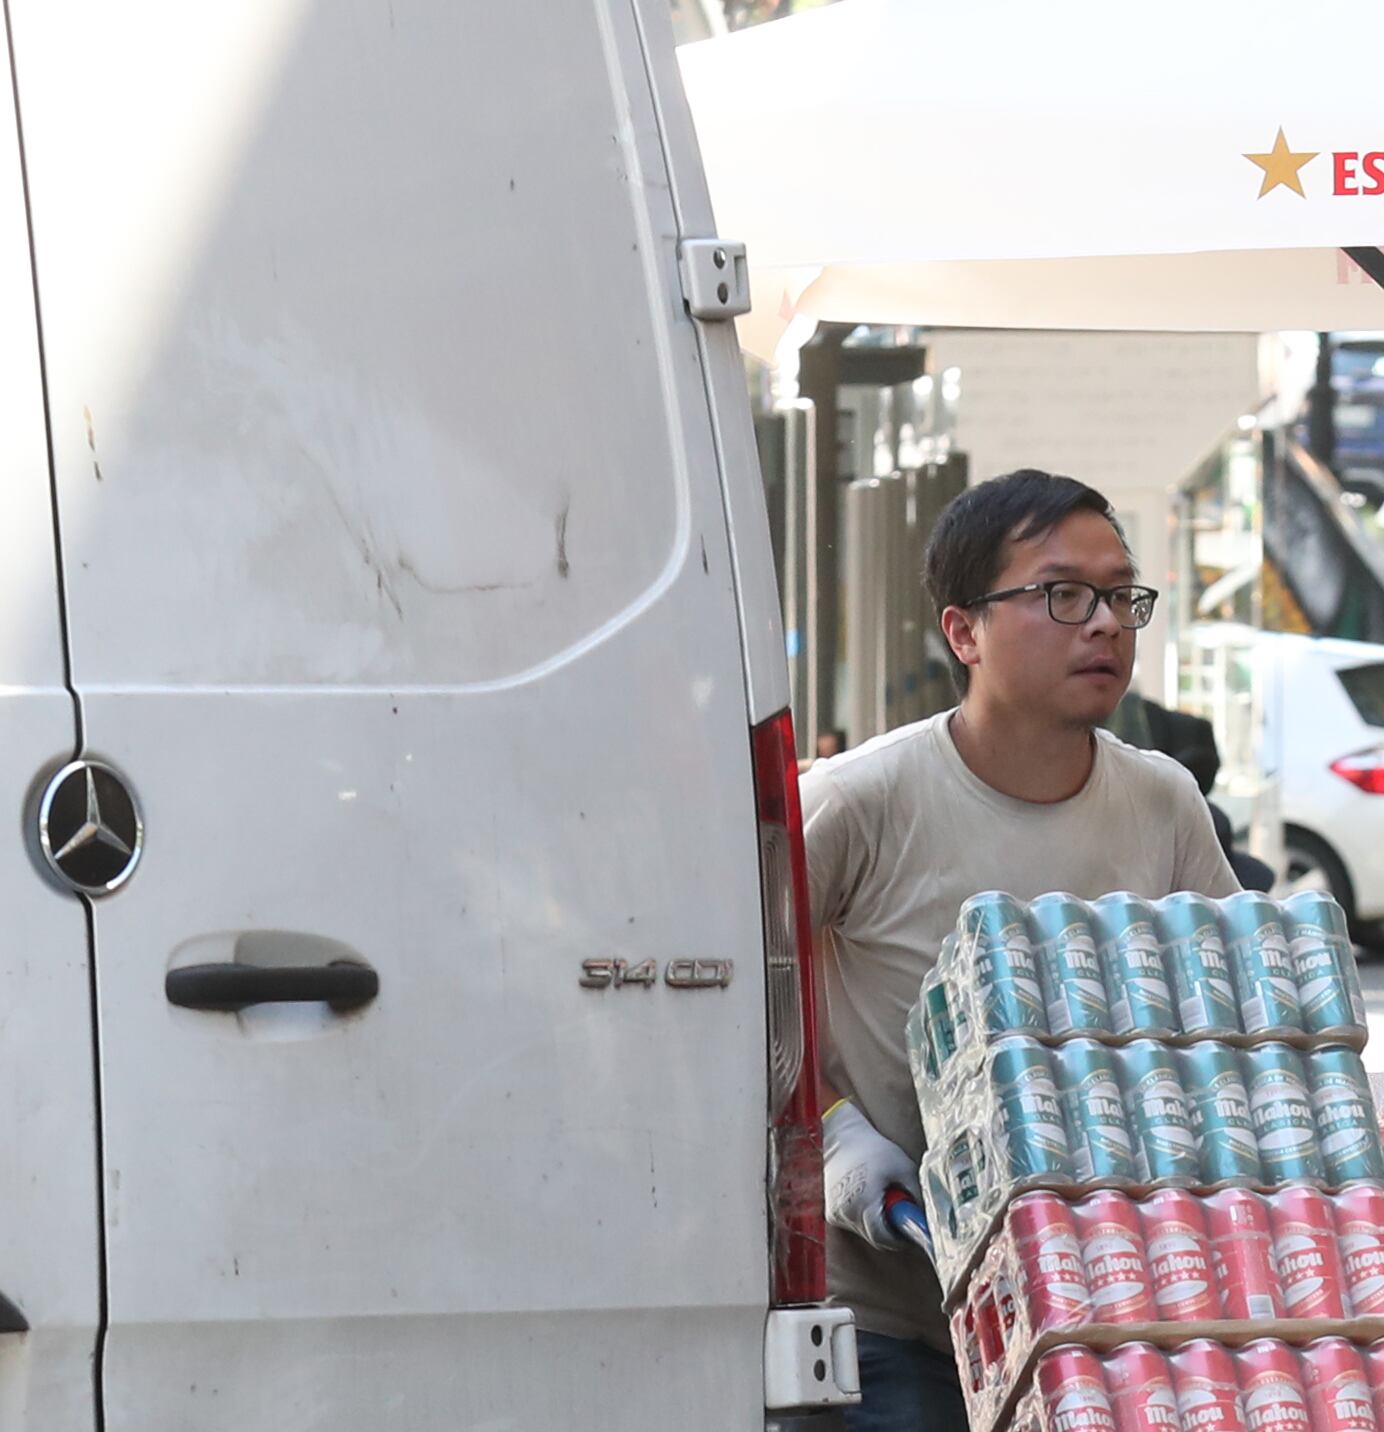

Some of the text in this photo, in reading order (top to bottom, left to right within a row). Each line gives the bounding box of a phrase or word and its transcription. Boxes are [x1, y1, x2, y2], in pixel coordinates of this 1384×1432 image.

[578, 957, 735, 990] 314 CDI
[1317, 1104, 1366, 1126] ahou
